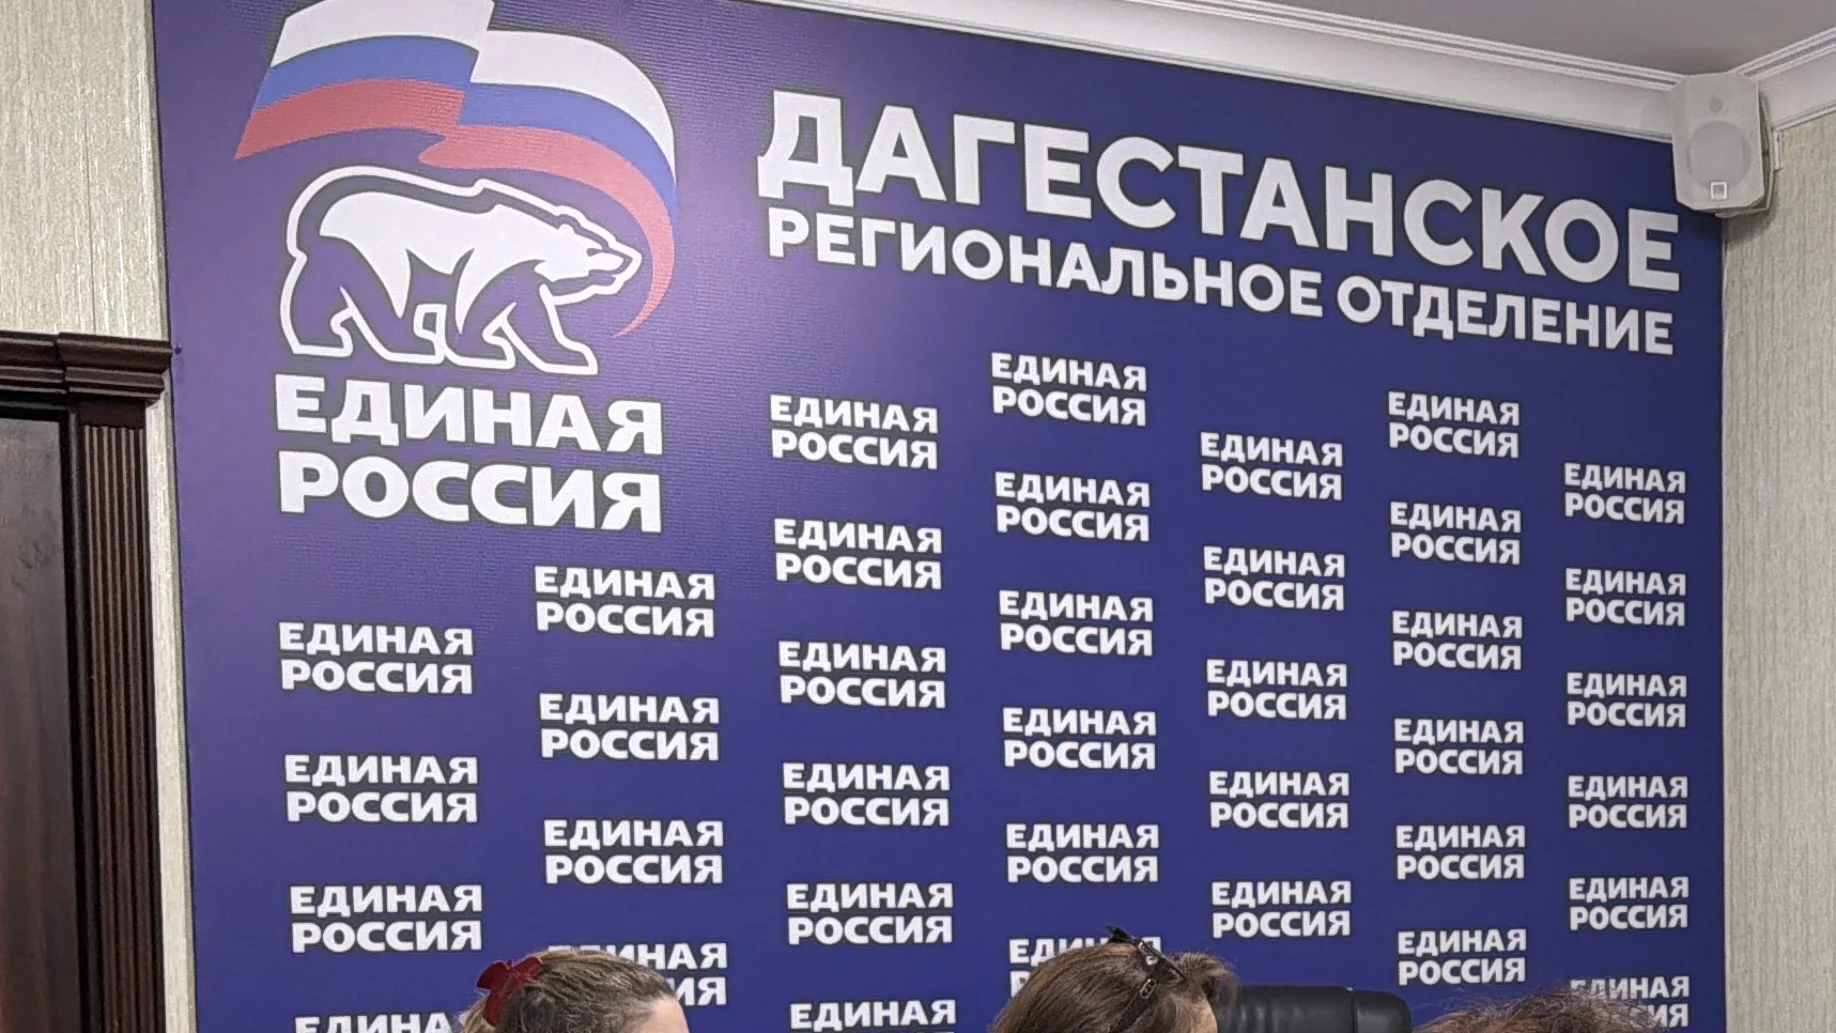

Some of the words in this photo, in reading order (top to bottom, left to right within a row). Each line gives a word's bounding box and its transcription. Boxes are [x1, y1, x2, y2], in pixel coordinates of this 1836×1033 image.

[757, 89, 1681, 291] ДАГЕСТАНСКОЕ
[768, 206, 1323, 318] РЕГИОНАЛЬНОЕ
[1336, 274, 1675, 356] ОТДЕЛЕНИЕ
[991, 352, 1147, 392] ЕДИНАЯ
[274, 373, 664, 456] ЕДИНАЯ
[769, 393, 939, 434] ЕДИНАЯ
[992, 385, 1146, 427] РОССИЯ
[1388, 391, 1519, 426] ЕДИНАЯ
[770, 428, 938, 470] РОССИЯ
[1200, 432, 1343, 467] ЕДИНАЯ
[1389, 422, 1518, 458] РОССИЯ
[278, 449, 662, 534] РОССИЯ
[995, 471, 1150, 508] ЕДИНАЯ
[1201, 463, 1342, 501] РОССИЯ
[1564, 463, 1685, 493] ЕДИНАЯ
[996, 504, 1149, 542] РОССИЯ
[1390, 501, 1521, 533] ЕДИНАЯ
[1565, 492, 1684, 524] РОССИЯ
[773, 517, 942, 554] ЕДИНАЯ
[1391, 532, 1520, 565] РОССИЯ
[775, 551, 942, 590] РОССИЯ
[1203, 546, 1345, 578] ЕДИНАЯ
[534, 565, 716, 601] ЕДИНАЯ
[1204, 577, 1344, 611] РОССИЯ
[1566, 568, 1686, 595] ЕДИНАЯ
[535, 600, 715, 638] РОССИЯ
[998, 589, 1153, 622] ЕДИНАЯ
[1566, 597, 1685, 626] РОССИЯ
[278, 621, 474, 657] ЕДИНАЯ
[1000, 622, 1153, 657] РОССИЯ
[1392, 610, 1522, 639] ЕДИНАЯ
[778, 640, 946, 673] ЕДИНАЯ
[1393, 640, 1521, 670] РОССИЯ
[280, 658, 473, 695] РОССИЯ
[1206, 659, 1347, 688] ЕДИНАЯ
[1567, 672, 1687, 698] ЕДИНАЯ
[779, 674, 946, 709] РОССИЯ
[1207, 690, 1347, 720] РОССИЯ
[539, 692, 720, 726] ЕДИНАЯ
[1002, 707, 1157, 737] ЕДИНАЯ
[1567, 701, 1686, 727] РОССИЯ
[540, 728, 719, 761] РОССИЯ
[1394, 718, 1524, 746] ЕДИНАЯ
[1004, 739, 1156, 770] РОССИЯ
[1395, 748, 1523, 775] РОССИЯ
[284, 754, 478, 788] ЕДИНАЯ
[782, 762, 950, 793] ЕДИНАЯ
[1209, 770, 1349, 799] ЕДИНАЯ
[1568, 775, 1688, 801] ЕДИНАЯ
[286, 790, 478, 823] РОССИЯ
[784, 796, 949, 826] РОССИЯ
[1210, 801, 1349, 828] РОССИЯ
[1569, 804, 1687, 828] РОССИЯ
[543, 819, 724, 851] ЕДИНАЯ
[1006, 823, 1159, 852] ЕДИНАЯ
[1396, 825, 1525, 852] ЕДИНАЯ
[545, 854, 723, 885] РОССИЯ
[1007, 855, 1158, 883] РОССИЯ
[1397, 854, 1524, 880] РОССИЯ
[290, 884, 483, 918] ЕДИНАЯ
[786, 882, 953, 913] ЕДИНАЯ
[1211, 880, 1351, 909] ЕДИНАЯ
[1569, 876, 1689, 903] ЕДИНАЯ
[788, 915, 953, 945] РОССИЯ
[1212, 910, 1350, 939] РОССИЯ
[1570, 904, 1687, 930] РОССИЯ
[291, 920, 482, 953] РОССИЯ
[1398, 929, 1526, 957] ЕДИНАЯ
[1398, 957, 1525, 986] РОССИЯ
[790, 999, 956, 1033] ЕДИНАЯ
